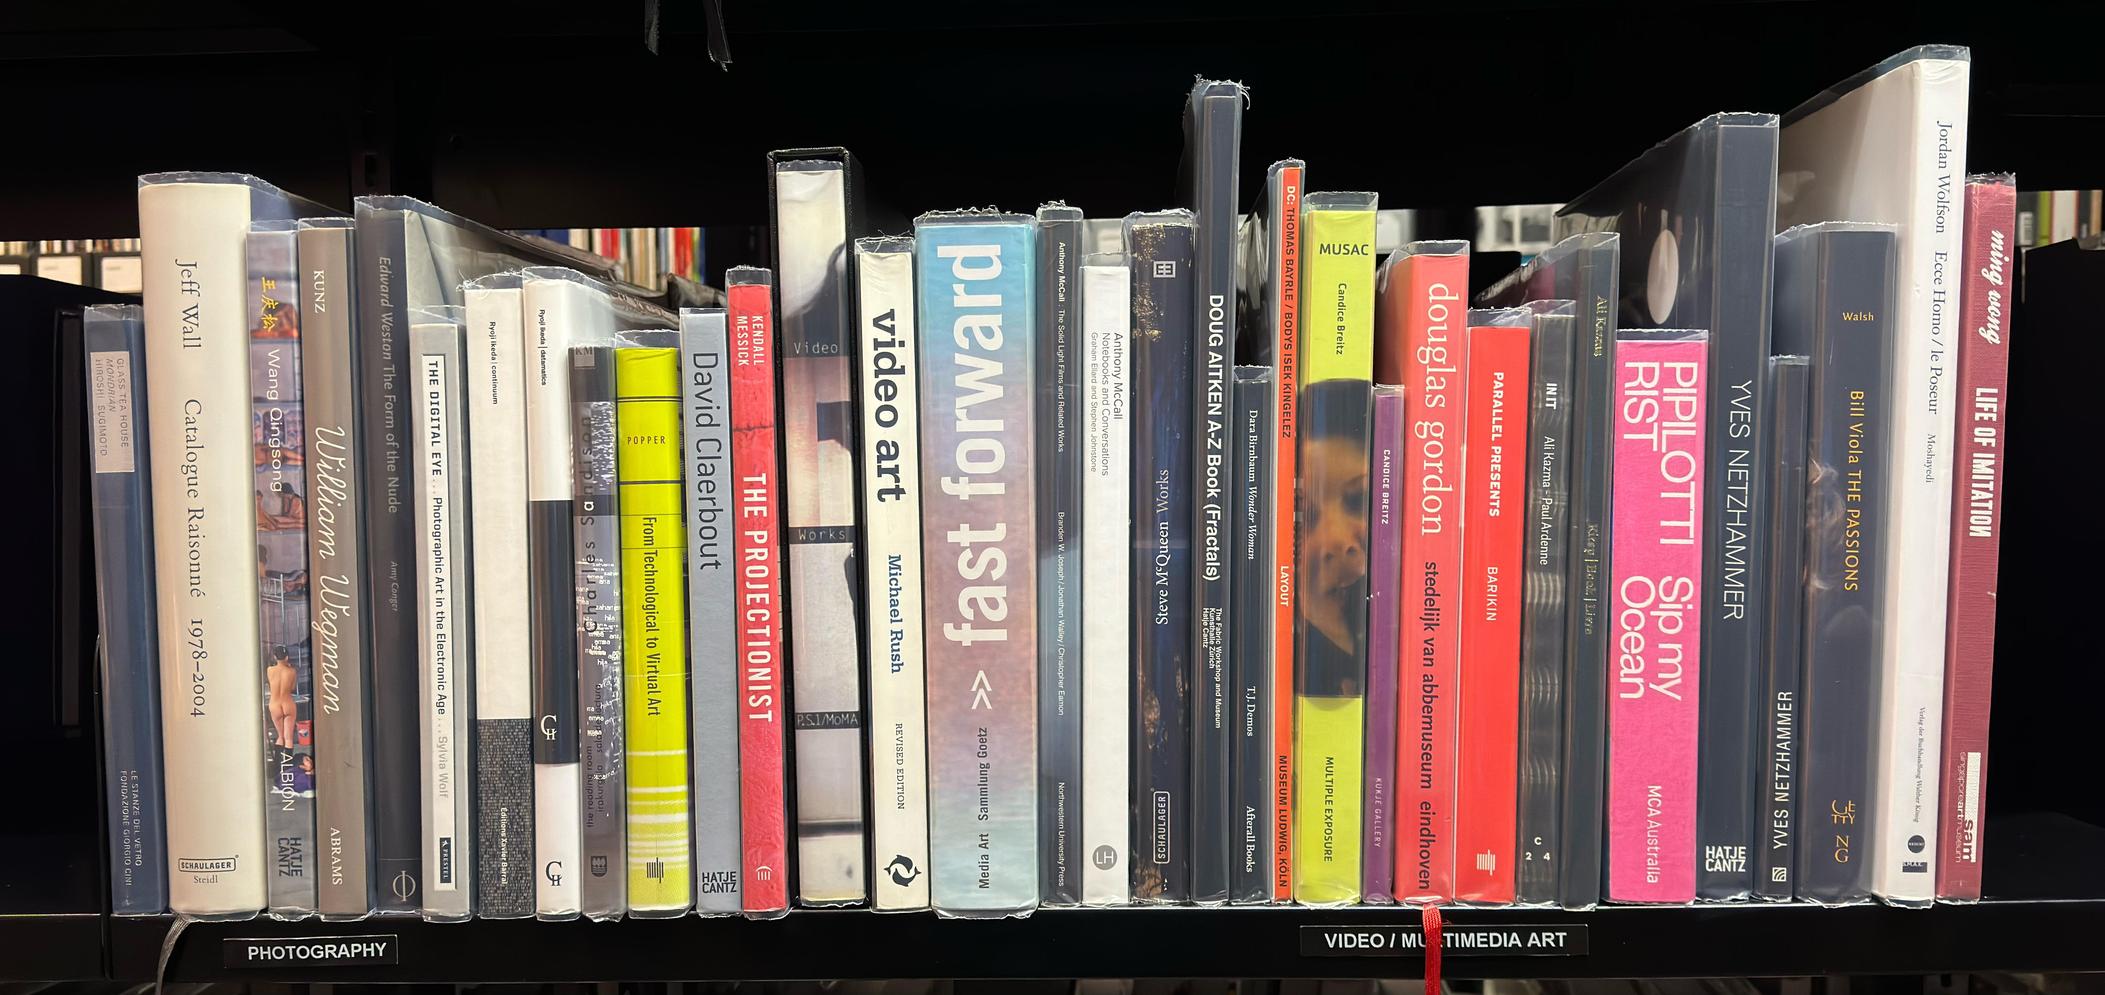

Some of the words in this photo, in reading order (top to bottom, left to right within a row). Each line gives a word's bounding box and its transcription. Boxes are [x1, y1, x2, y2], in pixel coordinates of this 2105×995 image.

[1936, 120, 1952, 169] Jordan
[1286, 186, 1296, 205] DC:
[1936, 174, 1952, 234] Wolfson
[1286, 208, 1294, 255] THOMAS
[1319, 244, 1369, 256] MUSAC
[176, 258, 200, 297] Jeff
[1057, 242, 1066, 277] Anthony
[1284, 258, 1294, 301] BAYRLE
[1934, 251, 1948, 285] Ecce
[1980, 230, 2009, 287] ming
[313, 270, 326, 313] KUNZ
[379, 256, 392, 306] Edward
[1338, 282, 1347, 322] Candice
[181, 304, 202, 350] Wall
[1209, 295, 1224, 347] DOUG
[1284, 312, 1293, 350] BODYS
[1842, 312, 1874, 321] Walsh
[1932, 288, 1946, 336] Homo
[1978, 290, 2002, 345] wong
[381, 313, 392, 360] Weston
[736, 316, 750, 366] MESSICK
[752, 316, 764, 365] KENDALL
[794, 342, 839, 355] Video
[1056, 346, 1065, 364] Light
[1102, 332, 1110, 384] Notebooks
[1112, 333, 1123, 380] Anthony
[1336, 324, 1346, 356] Breitz
[1417, 282, 1460, 408] douglas
[267, 348, 280, 400] Wang
[383, 364, 394, 390] The
[428, 360, 438, 386] THE
[872, 308, 906, 428] video
[937, 244, 1007, 500] forward
[1208, 350, 1223, 416] AITKEN
[1283, 353, 1292, 380] ISEK
[384, 394, 396, 428] Form
[693, 353, 720, 428] David
[1114, 383, 1124, 420] McCall
[1282, 384, 1292, 438] KINGELEZ
[1492, 372, 1504, 441] PARALLEL
[1623, 362, 1660, 452] RIST
[1729, 380, 1752, 438] YVES
[1850, 390, 1864, 417] Bill
[1928, 366, 1944, 414] Poseur
[1974, 387, 1998, 422] LIFE
[120, 415, 129, 448] HOUSE
[430, 392, 441, 445] DIGITAL
[627, 435, 666, 445] POPPER
[1207, 420, 1222, 450] A-Z
[1249, 410, 1258, 436] Dara
[1973, 426, 1996, 448] OF
[180, 398, 204, 499] Catalogue
[269, 408, 284, 492] Qingsong
[1102, 408, 1110, 476] Conversations
[1248, 439, 1258, 482] Birnbaum
[1660, 362, 1698, 544] PIPILOTTI
[1848, 422, 1864, 464] Viola
[314, 425, 348, 560] William
[876, 441, 907, 503] art
[1156, 469, 1168, 513] Works
[1206, 454, 1222, 498] Book
[1414, 420, 1453, 535] gordon
[1489, 446, 1502, 518] PRESENTS
[1847, 470, 1862, 502] THE
[388, 477, 400, 514] Nude
[696, 438, 724, 570] Claerbout
[744, 472, 768, 518] THE
[1248, 486, 1258, 522] Wonder
[1541, 498, 1552, 520] Paul
[187, 507, 204, 598] Raisonné
[432, 497, 444, 573] Photographic
[643, 517, 657, 547] From
[799, 528, 846, 542] Works
[1156, 521, 1171, 586] McQueen
[1202, 503, 1221, 582] (Fractals)
[1248, 524, 1257, 560] Woman
[1540, 521, 1552, 566] Ardenne
[1722, 450, 1750, 620] NETZHAMMER
[1844, 508, 1860, 591] PASSIONS
[435, 577, 444, 594] Art
[436, 597, 444, 607] in
[644, 549, 660, 628] Technological
[888, 554, 902, 624] Michael
[943, 523, 1008, 646] fast
[1280, 566, 1289, 607] LAYOUT
[1419, 562, 1440, 632] stedelijk
[1486, 566, 1498, 622] BARIKIN
[1650, 575, 1694, 635] Sip
[436, 610, 444, 630] the
[744, 530, 772, 722] PROJECTIONIST
[1156, 590, 1168, 625] Steve
[310, 573, 350, 714] Wegman
[646, 632, 658, 649] to
[890, 629, 904, 674] Rush
[1423, 636, 1434, 668] van
[1619, 575, 1656, 699] Ocean
[436, 633, 446, 691] Electronic
[647, 653, 660, 696] Virtual
[1214, 646, 1222, 682] Workshop
[1648, 643, 1684, 702] my
[648, 698, 661, 716] Art
[1247, 704, 1256, 736] Demos
[895, 723, 903, 764] REVISED
[976, 727, 988, 758] Goetz
[1420, 674, 1440, 790] abbemuseum
[1775, 690, 1793, 802] NETZHAMMER
[280, 752, 295, 811] ALBION
[439, 772, 448, 798] Wolf
[896, 768, 905, 810] EDITION
[978, 764, 990, 822] Sammlung
[1279, 755, 1288, 802] MUSEUM
[1324, 756, 1334, 806] MULTIPLE
[1647, 785, 1662, 817] MCA
[978, 833, 989, 852] Art
[1158, 796, 1166, 858] SCHAULAGER
[1246, 806, 1256, 843] Afterall
[1278, 805, 1287, 854] LUDWIG,
[1324, 808, 1333, 862] EXPOSURE
[1418, 801, 1437, 890] eindhoven
[1774, 808, 1789, 850] YVES
[124, 829, 132, 866] GIORGIO
[134, 837, 142, 867] VETRO
[181, 862, 232, 870] SCHAULAGER
[278, 838, 290, 877] CANTZ
[290, 837, 302, 877] HATJE
[330, 826, 342, 886] ABRAMS
[1246, 845, 1256, 872] Books
[1646, 820, 1662, 884] Australia
[1706, 846, 1747, 859] HATJE
[1706, 859, 1746, 872] CANTZ
[193, 875, 218, 884] Steidl
[702, 872, 737, 883] HATJE
[702, 882, 737, 894] CANTZ
[978, 855, 989, 889] Media
[1279, 859, 1289, 888] KÖLN
[248, 942, 387, 960] PHOTOGRAPHY
[1324, 933, 1385, 948] VIDEO
[1402, 932, 1522, 948] MUTIMEDIA
[1527, 932, 1567, 948] ART
